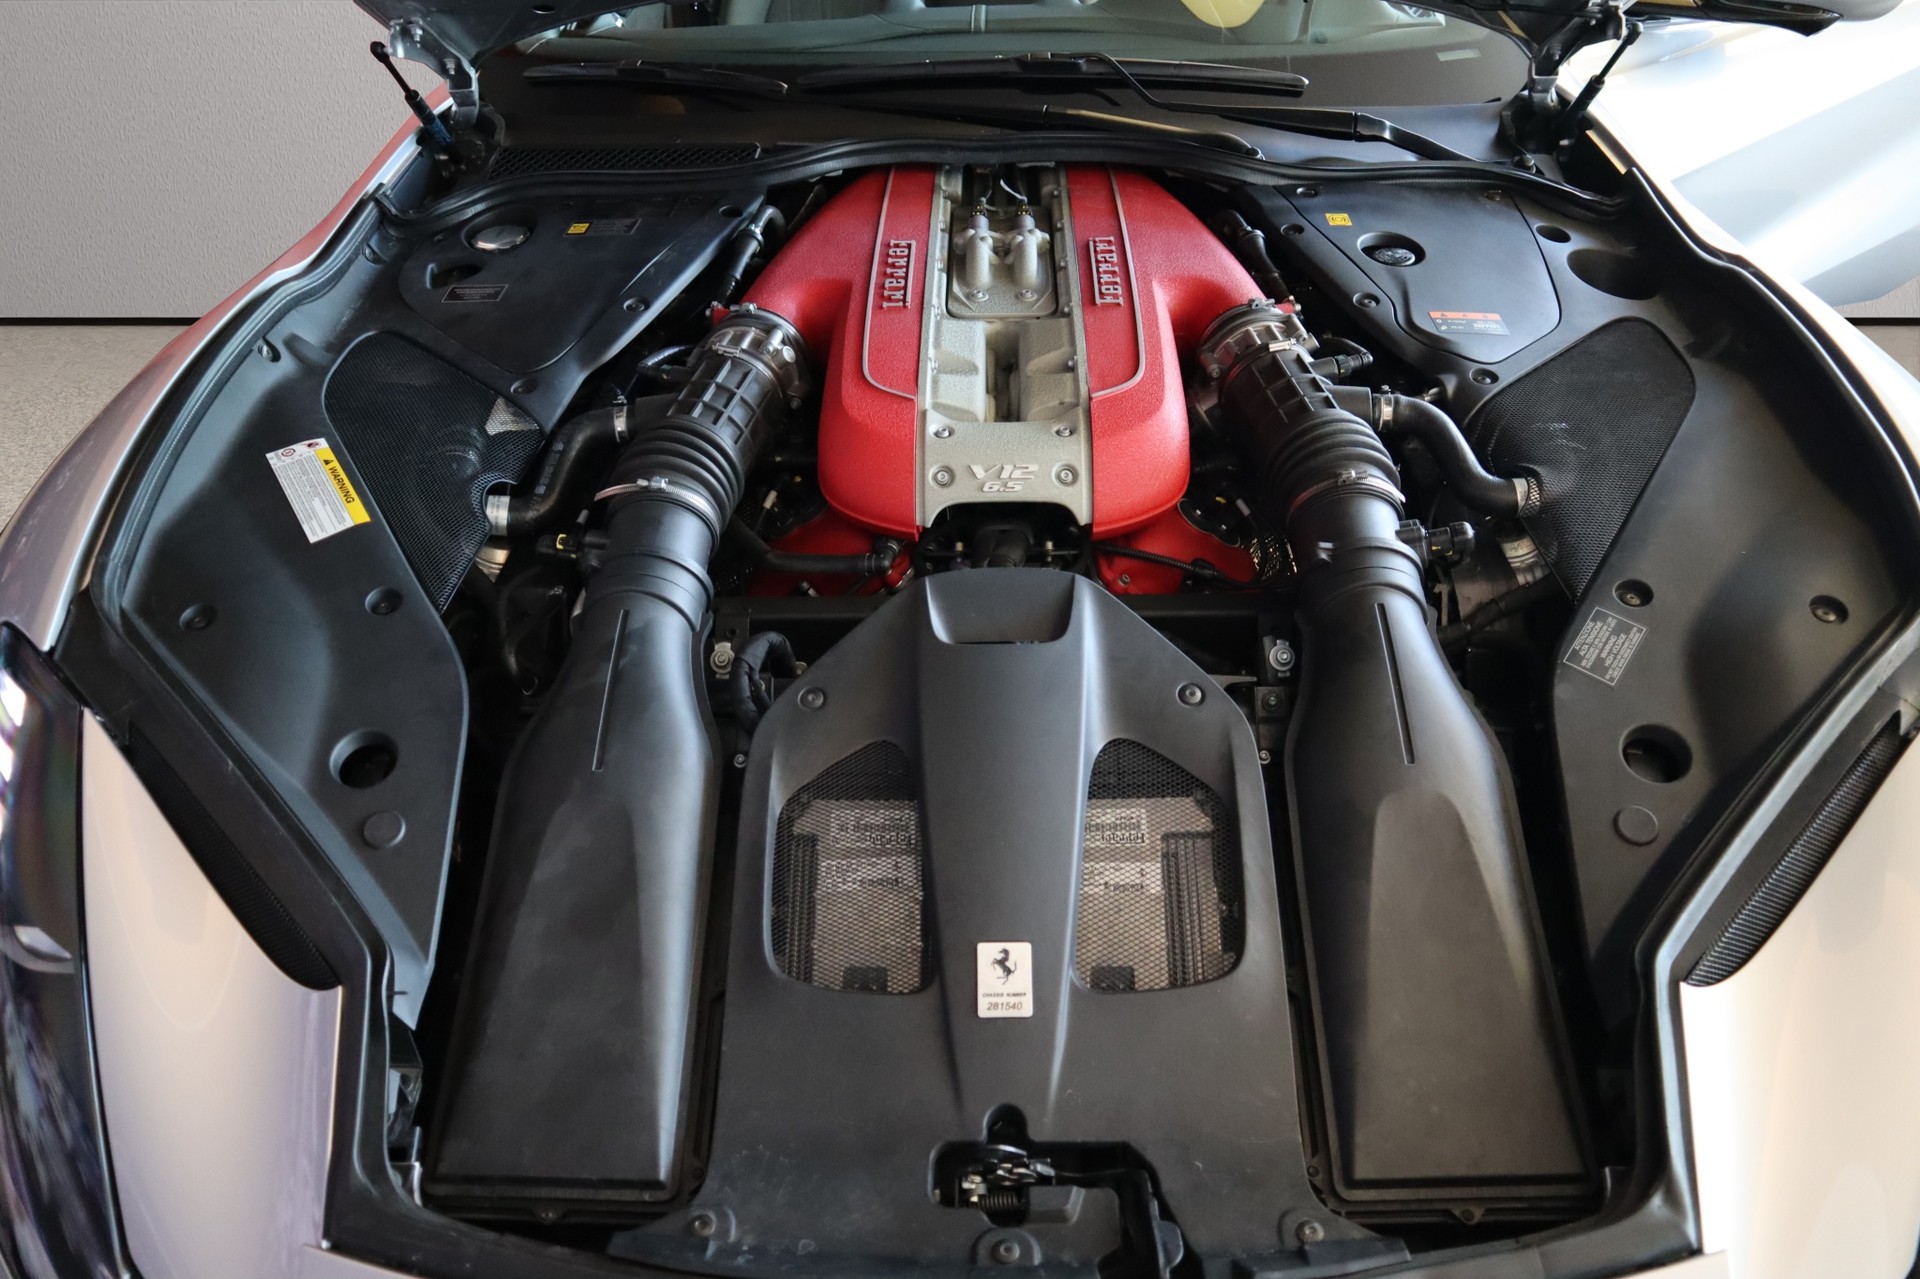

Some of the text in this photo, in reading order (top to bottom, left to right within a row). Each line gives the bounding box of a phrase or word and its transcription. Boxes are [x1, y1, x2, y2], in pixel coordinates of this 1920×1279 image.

[882, 239, 917, 309] Ferrari
[1088, 236, 1124, 307] Ferrari
[329, 465, 355, 504] WARNING
[968, 464, 1039, 480] V12
[982, 481, 1024, 492] 6.5
[986, 1001, 1023, 1011] 281540
